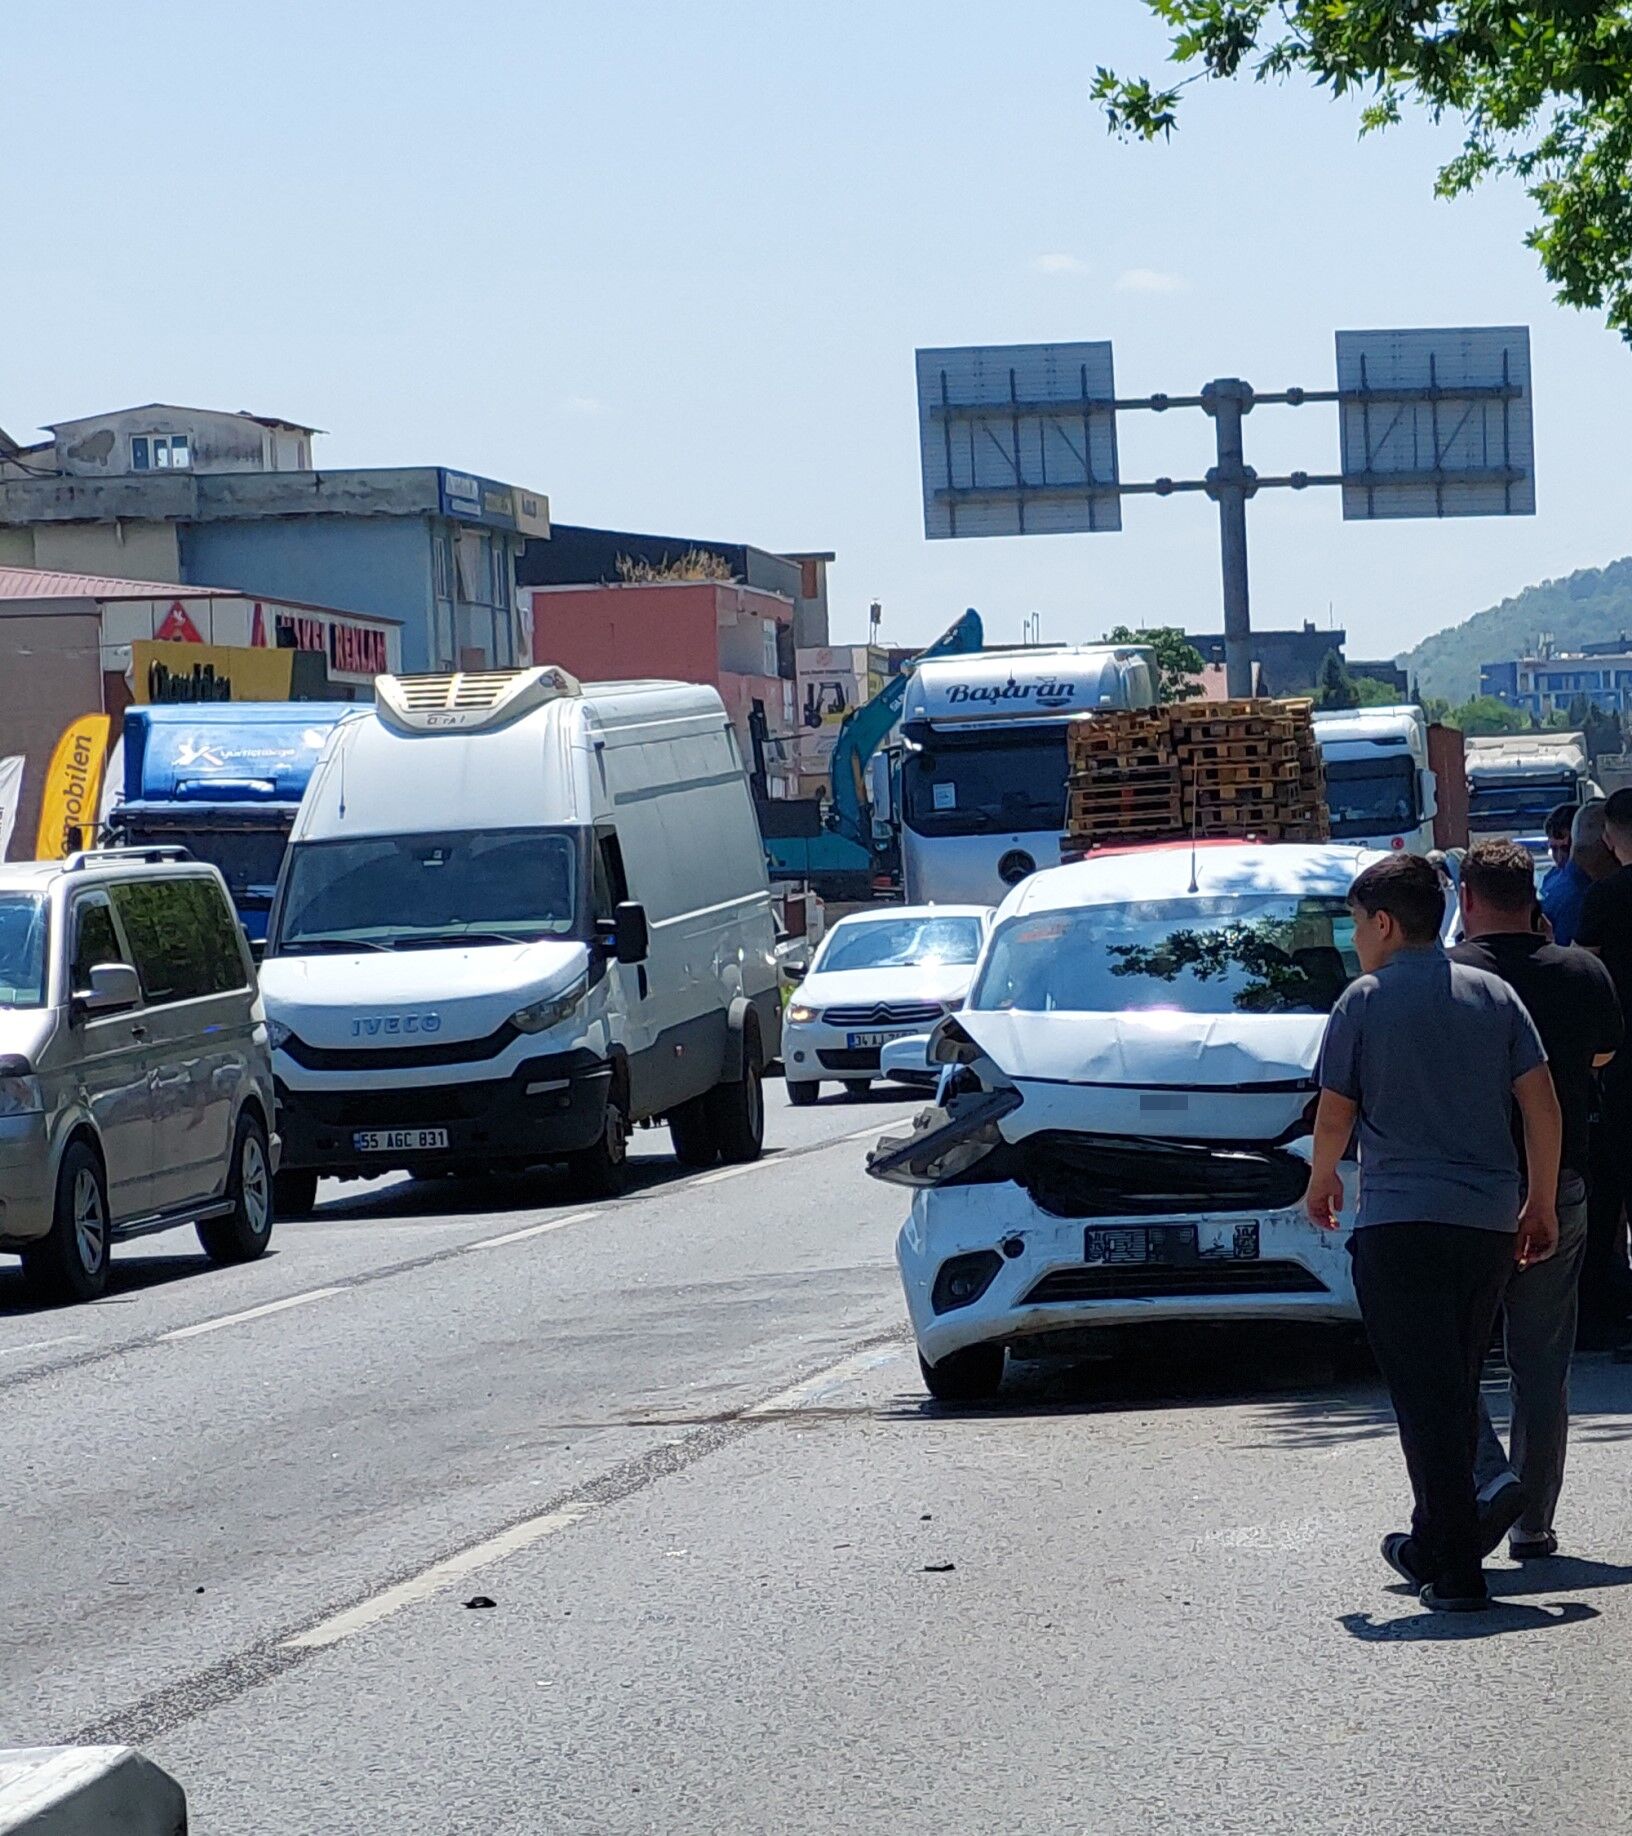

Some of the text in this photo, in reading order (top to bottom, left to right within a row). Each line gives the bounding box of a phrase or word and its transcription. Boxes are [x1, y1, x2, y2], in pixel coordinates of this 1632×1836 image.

[352, 1012, 441, 1036] IVECO
[361, 1131, 445, 1148] 55 AGC 831
